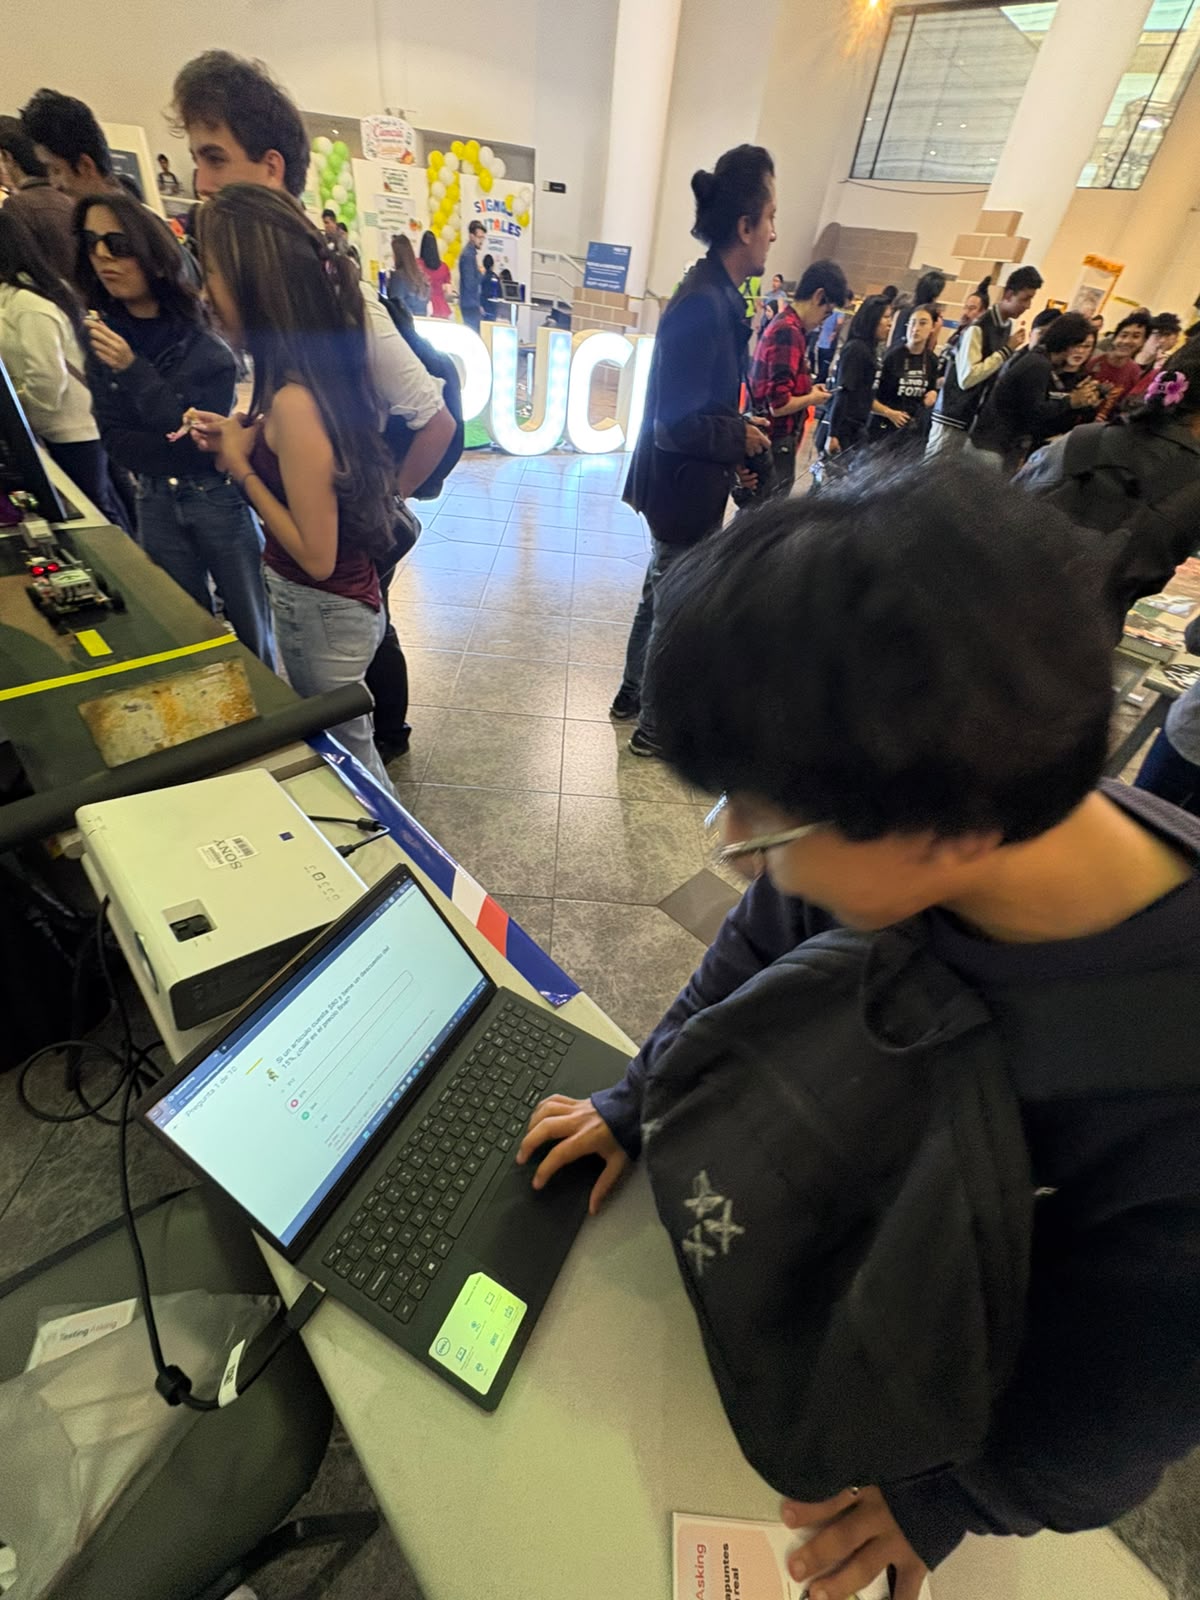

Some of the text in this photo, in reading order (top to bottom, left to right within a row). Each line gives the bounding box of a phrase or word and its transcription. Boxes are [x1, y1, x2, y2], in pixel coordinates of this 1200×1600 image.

[473, 198, 513, 217] SIGN
[213, 839, 243, 870] SONY
[695, 1543, 707, 1600] Asking
[723, 1542, 733, 1600] apuntes
[731, 1567, 740, 1596] real
